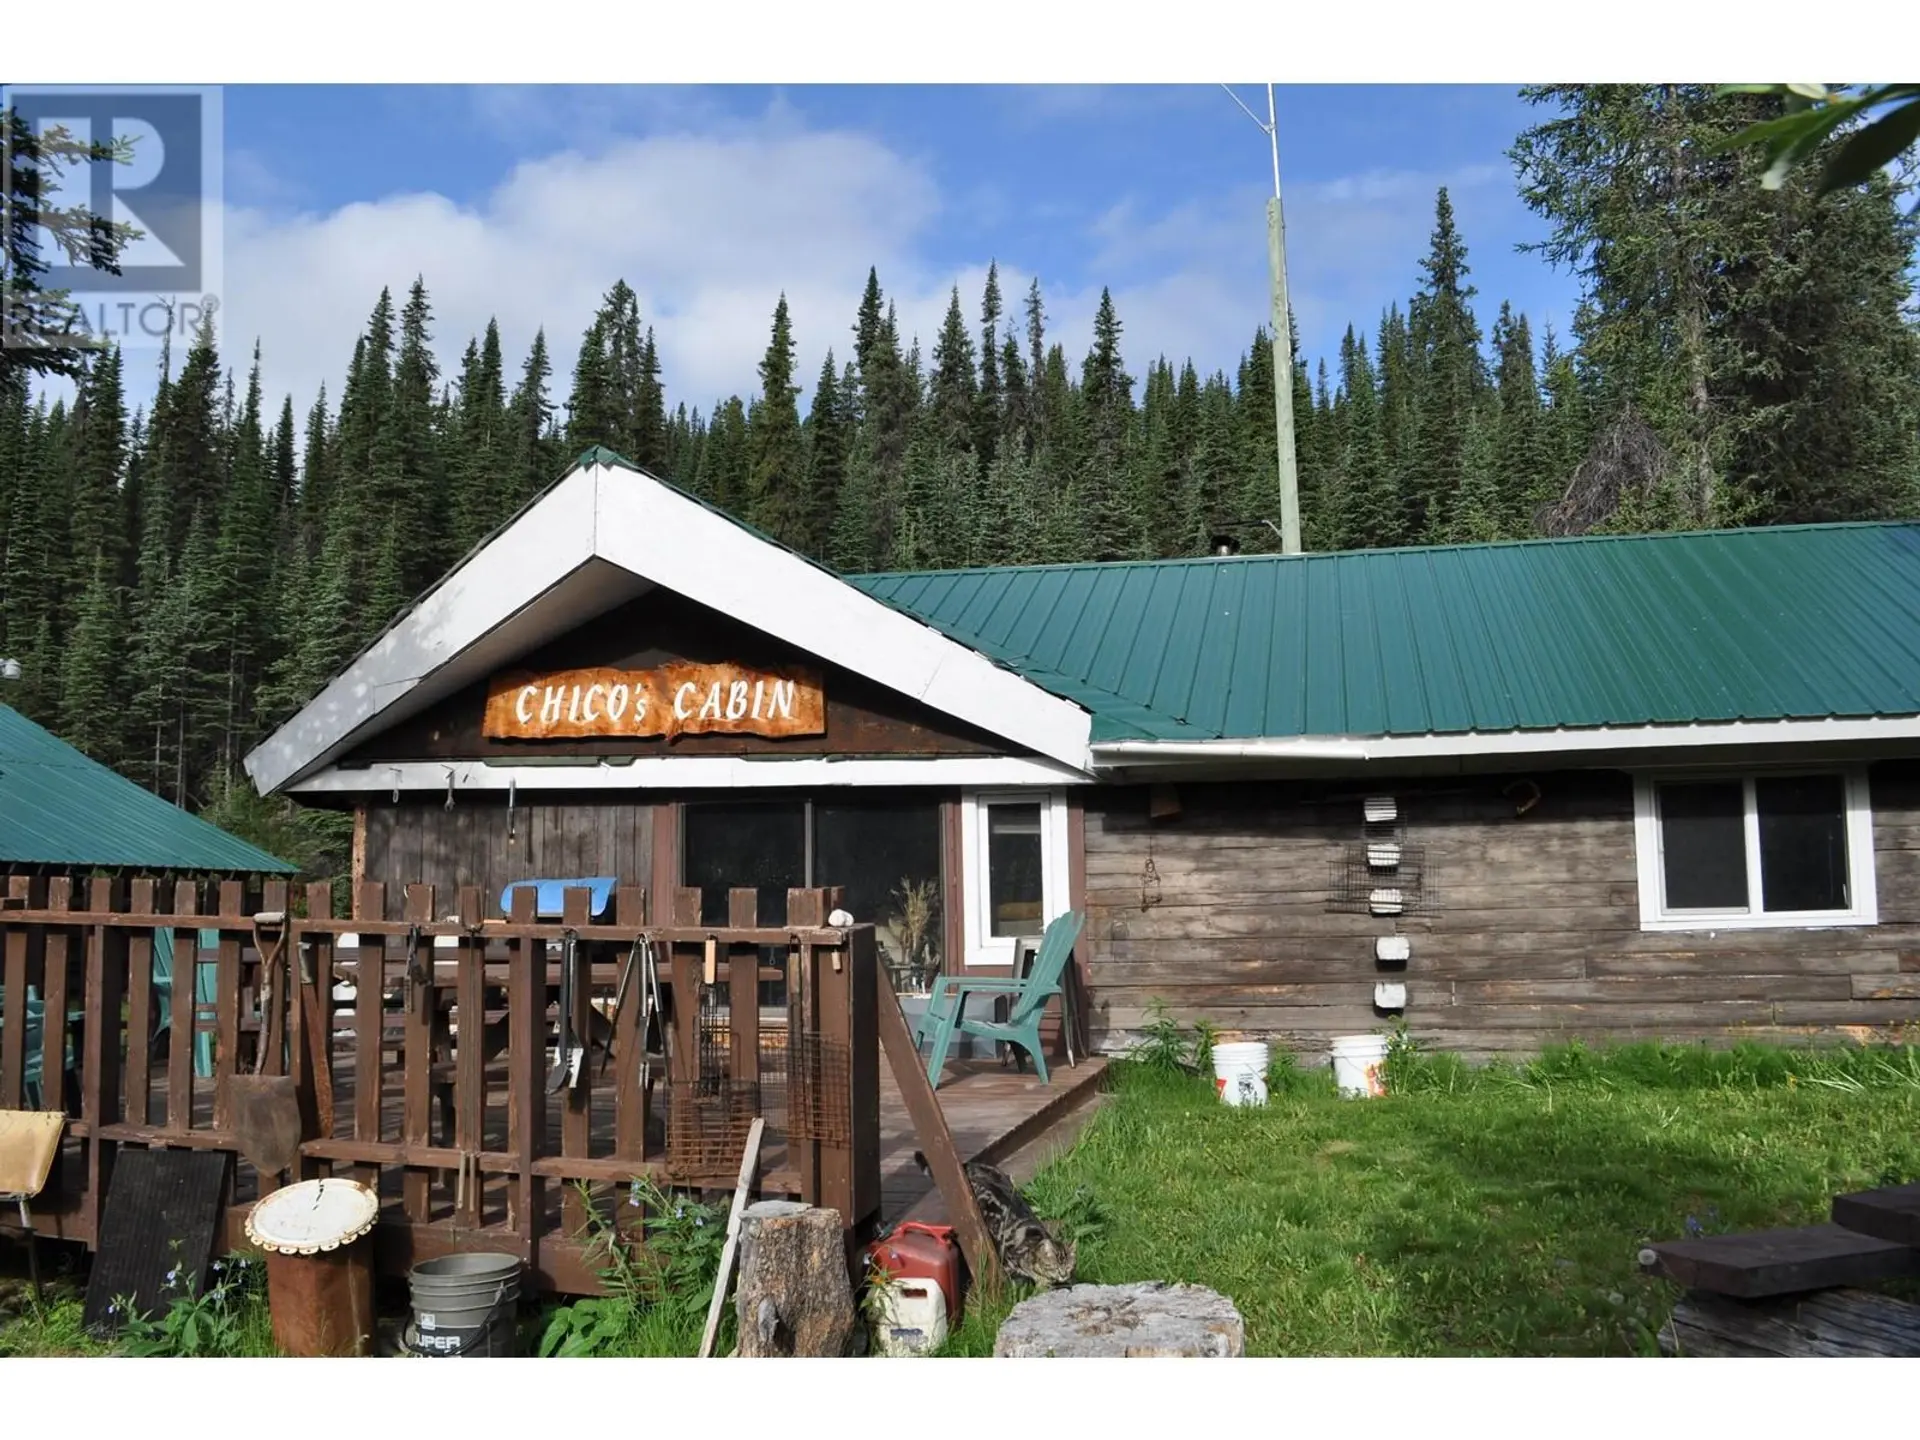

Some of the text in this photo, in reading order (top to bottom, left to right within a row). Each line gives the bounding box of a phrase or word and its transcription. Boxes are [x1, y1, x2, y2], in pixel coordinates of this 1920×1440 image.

[515, 679, 796, 725] CHICO's CABIN
[416, 1334, 461, 1349] UPER
